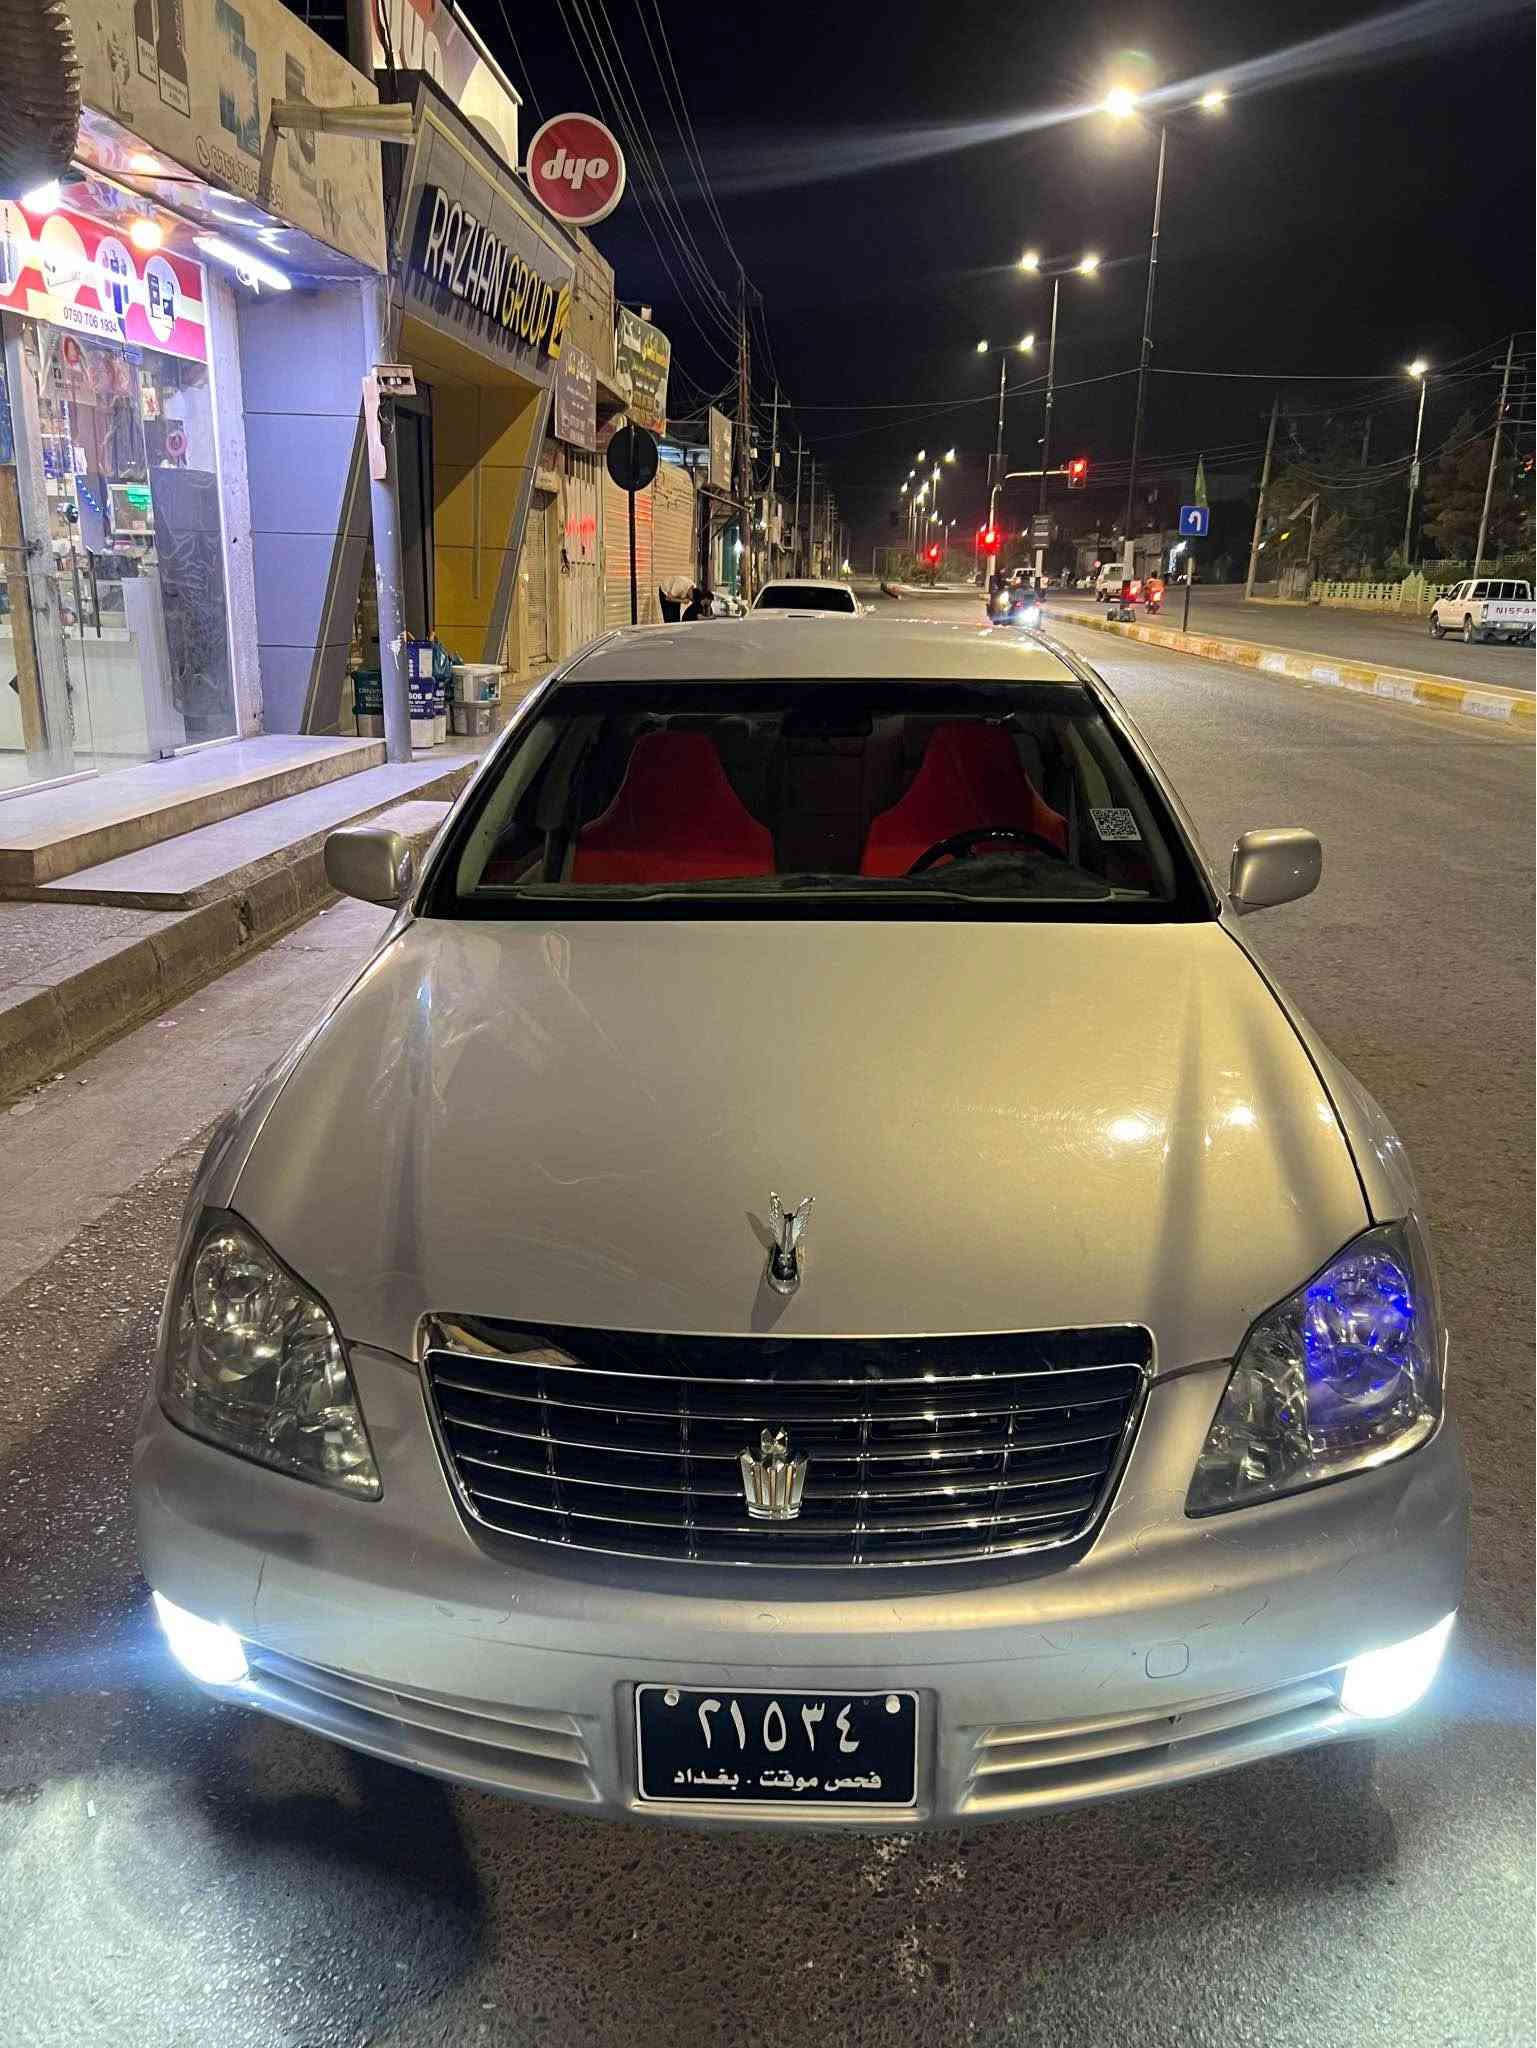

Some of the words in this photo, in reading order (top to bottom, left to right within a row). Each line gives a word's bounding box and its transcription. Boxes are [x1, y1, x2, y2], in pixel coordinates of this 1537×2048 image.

[541, 149, 609, 189] dyo
[424, 188, 508, 318] RAZHAN
[502, 255, 553, 346] GROUP
[698, 1699, 859, 1752] ٢١٥٣٤
[674, 1768, 739, 1791] بغداد
[759, 1770, 818, 1791] موقت
[824, 1771, 882, 1792] فحص
